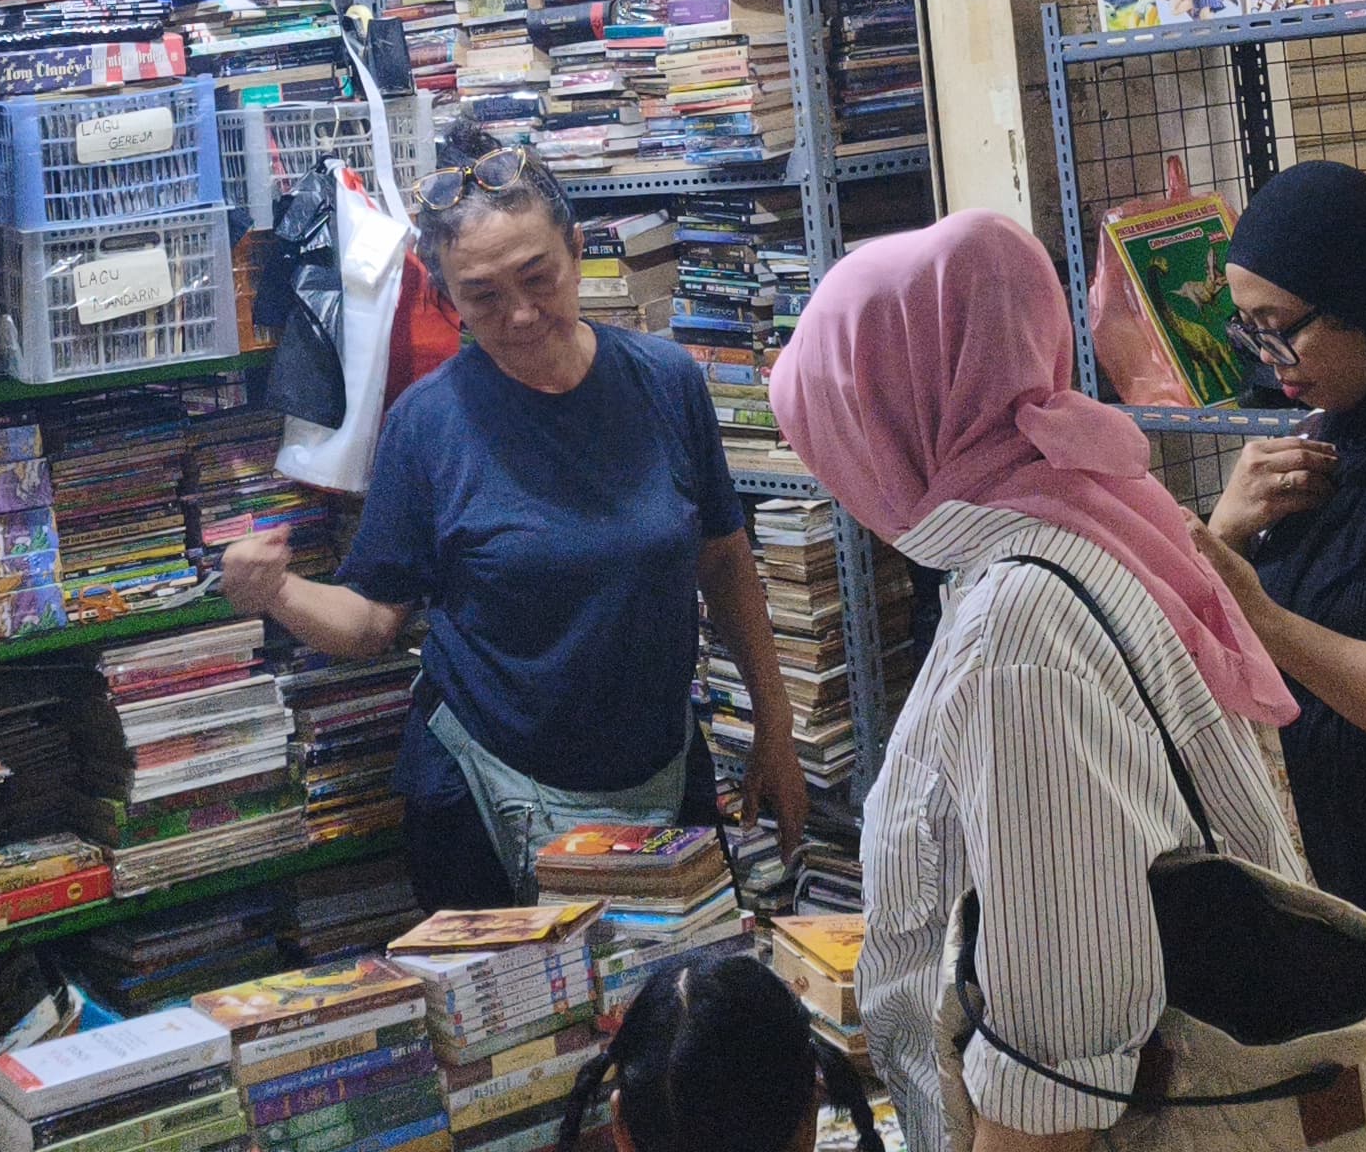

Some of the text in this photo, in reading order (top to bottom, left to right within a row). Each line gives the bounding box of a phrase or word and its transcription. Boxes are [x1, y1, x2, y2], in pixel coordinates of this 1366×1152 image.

[3, 66, 32, 81] Tom
[81, 119, 120, 136] LAGU
[108, 131, 154, 149] GEREJA
[78, 269, 120, 288] LAGU
[93, 288, 160, 313] MANDARIN
